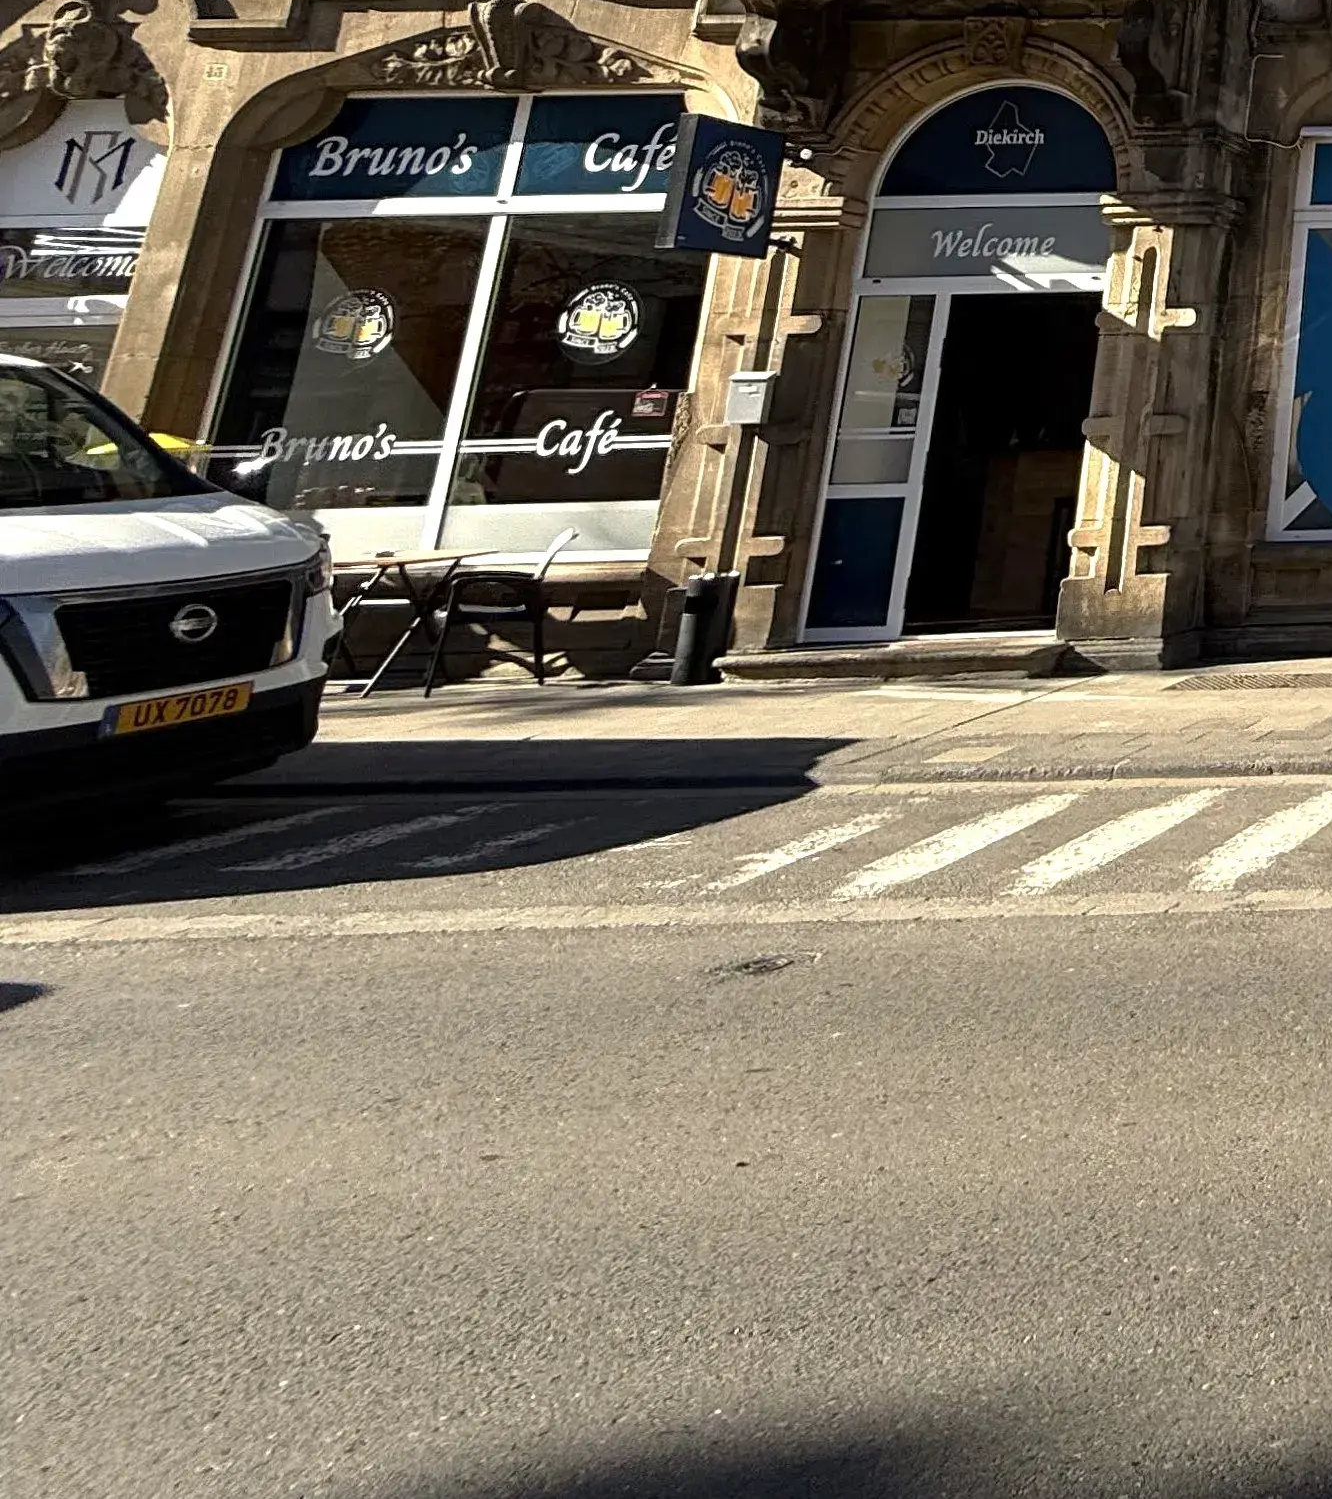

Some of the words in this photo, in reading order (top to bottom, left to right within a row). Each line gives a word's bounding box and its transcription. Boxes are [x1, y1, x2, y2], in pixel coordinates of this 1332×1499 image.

[309, 133, 477, 177] Bruno's
[584, 122, 677, 192] Café
[974, 128, 1045, 146] Diekirch
[931, 223, 1056, 258] Welcome
[262, 422, 396, 462] Bruno's
[536, 410, 622, 475] Café
[133, 700, 168, 728] UX
[175, 688, 239, 720] 7078
